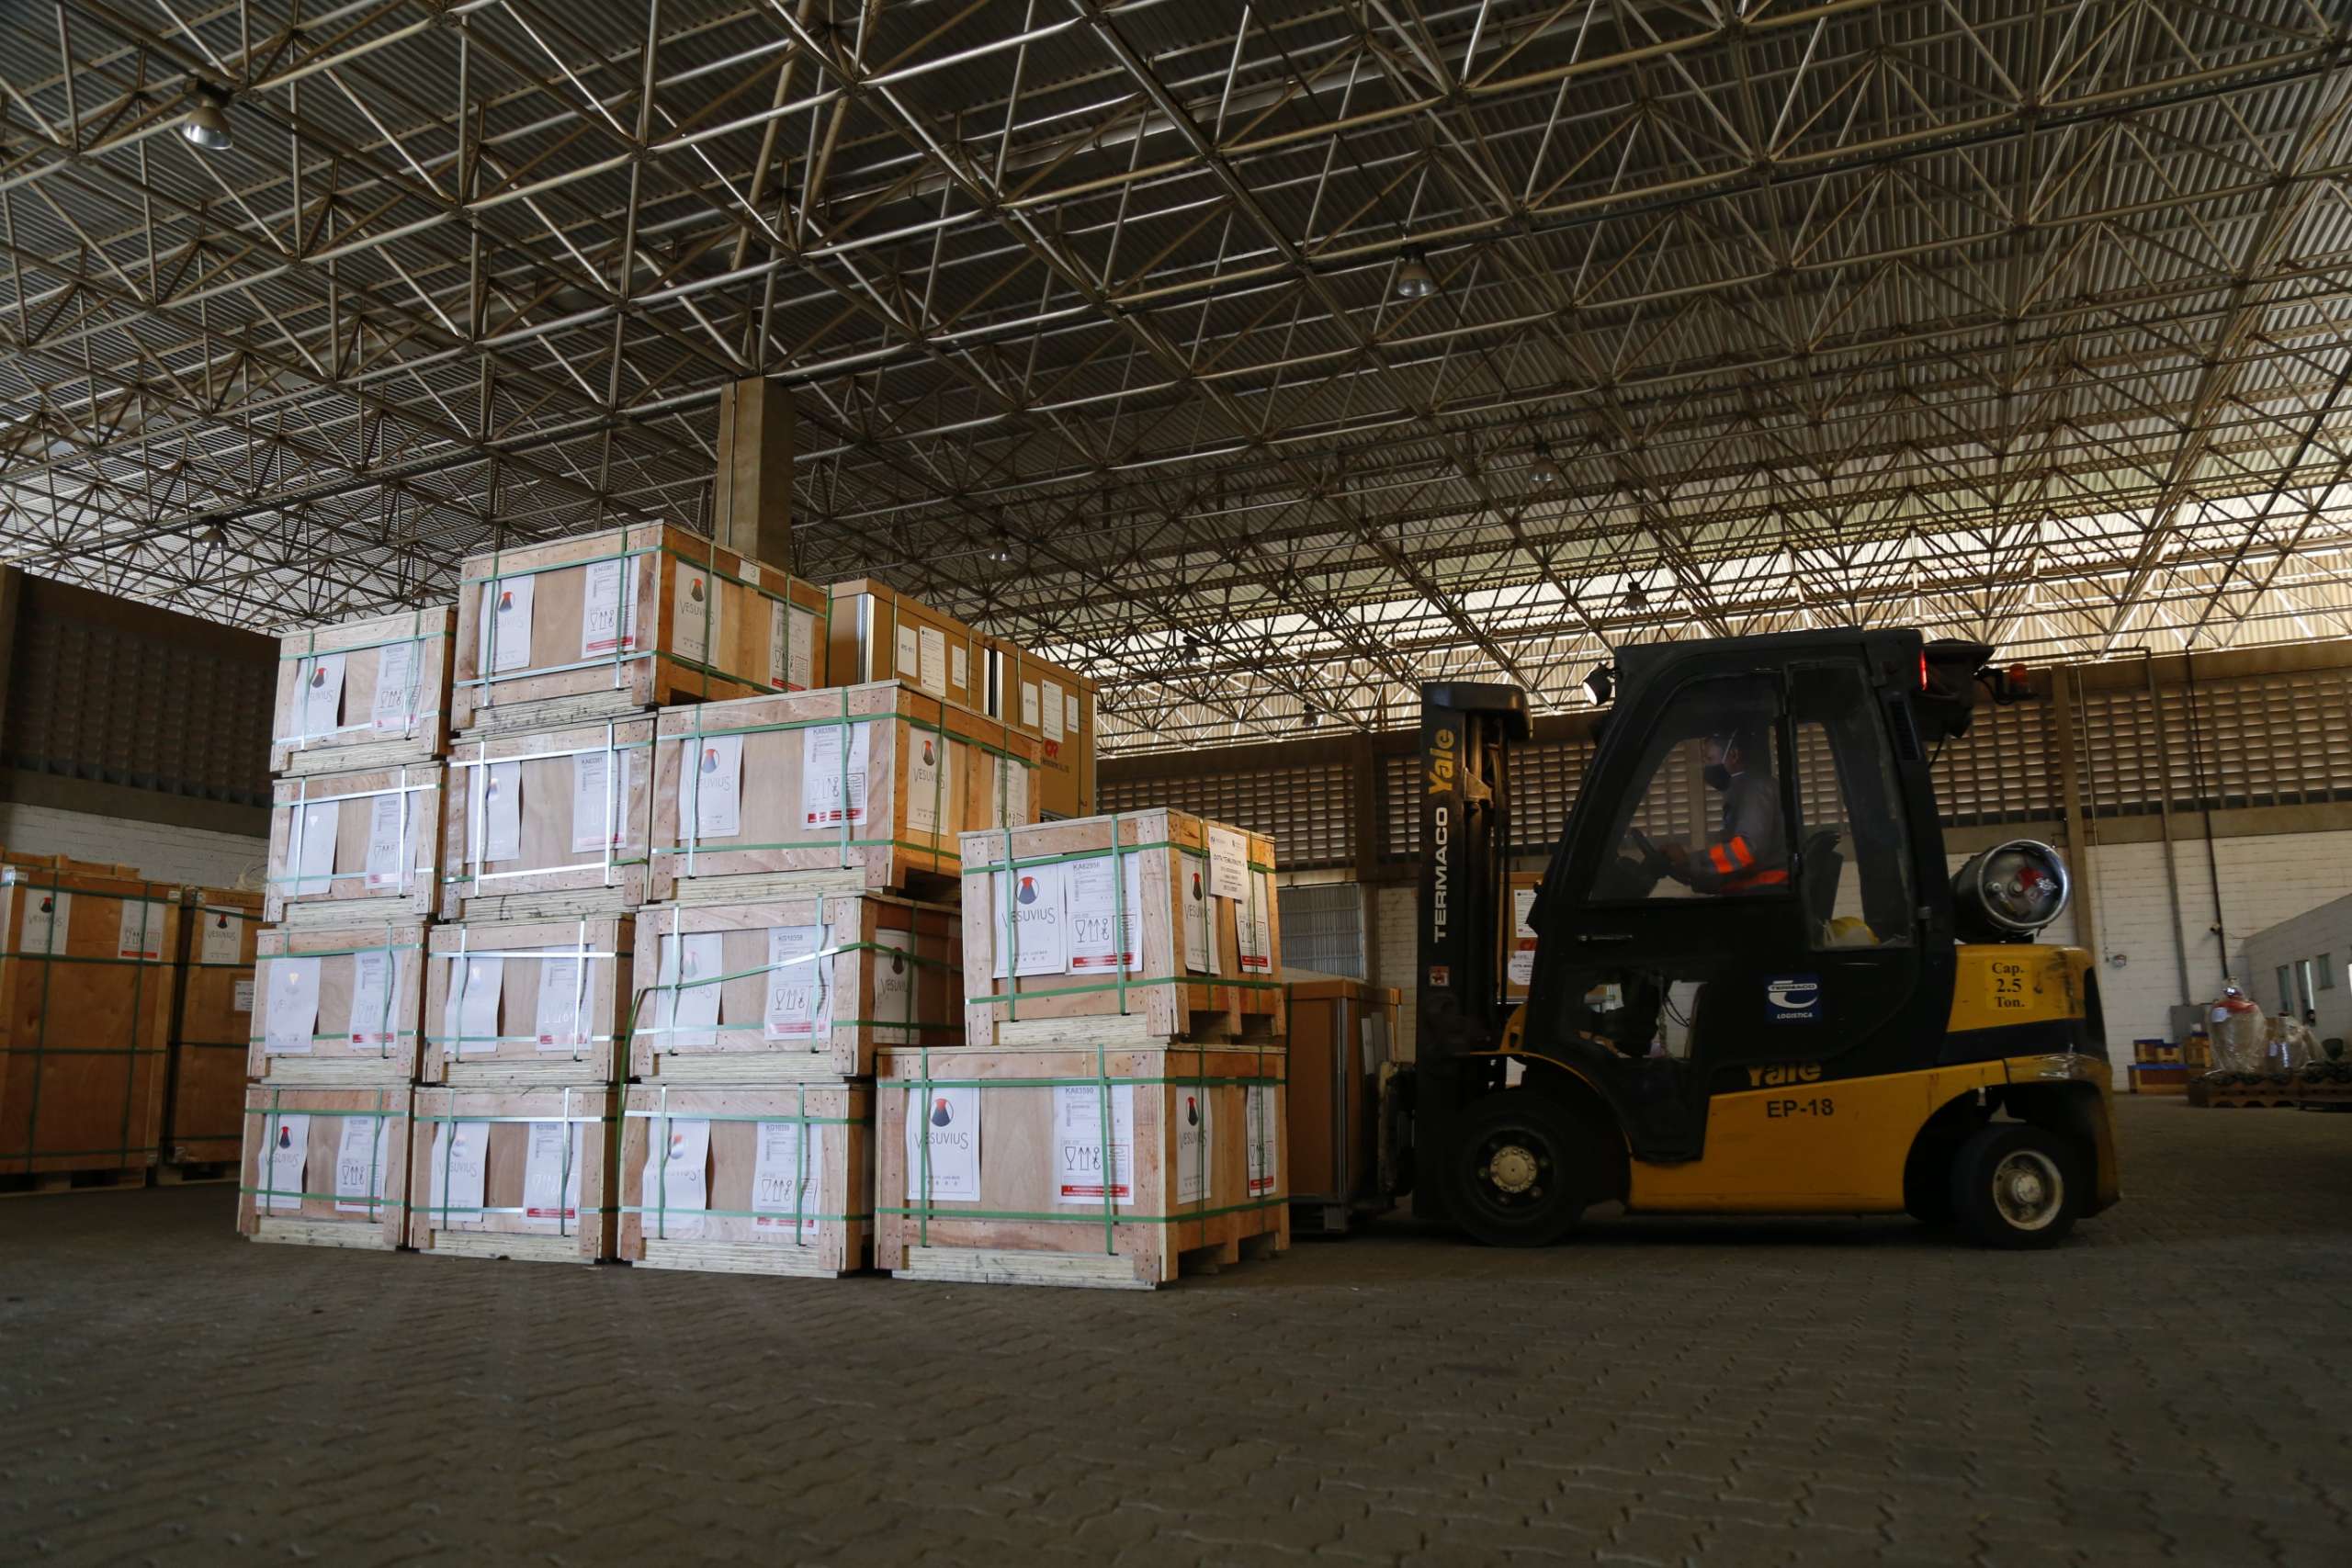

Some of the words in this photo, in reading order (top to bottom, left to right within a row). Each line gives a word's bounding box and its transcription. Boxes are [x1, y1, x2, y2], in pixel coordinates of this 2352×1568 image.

[1428, 728, 1455, 795] Yale
[1434, 807, 1449, 943] TERMACO
[1992, 962, 2025, 976] Cap.
[1996, 978, 2022, 992] 2.5
[1994, 997, 2025, 1008] Ton.
[1748, 1061, 1821, 1087] Yale
[1767, 1098, 1835, 1118] EP-18
